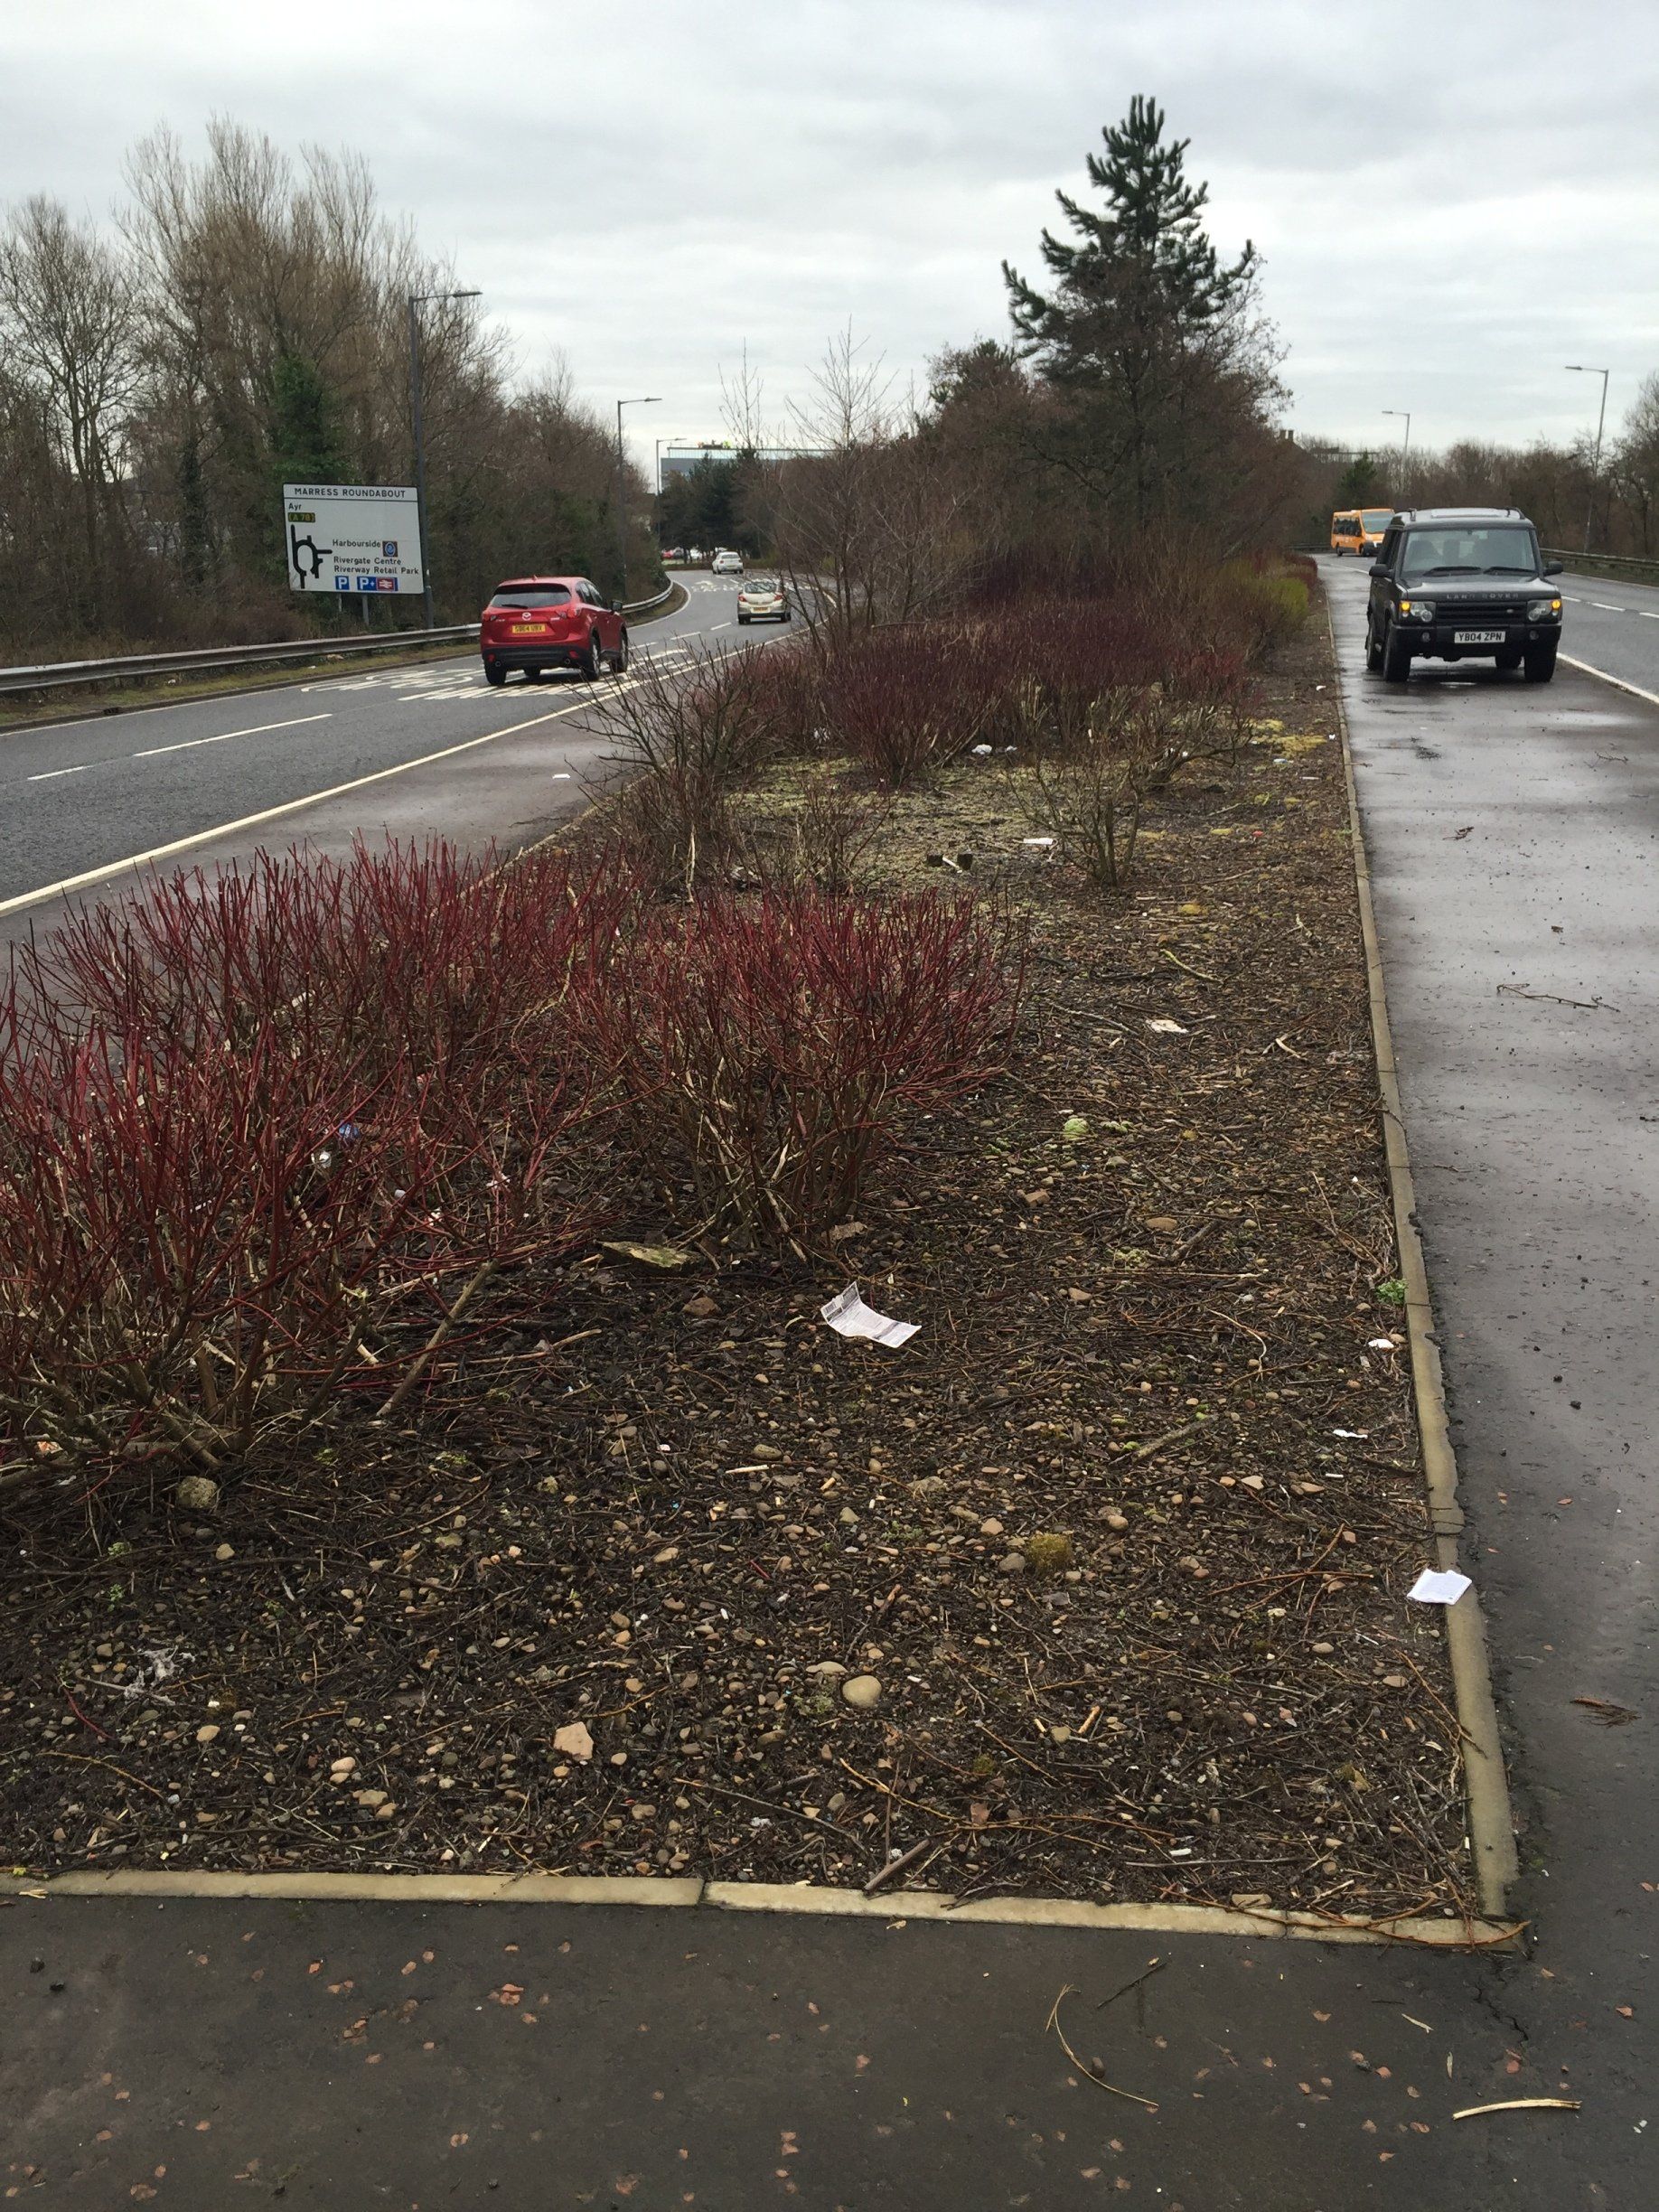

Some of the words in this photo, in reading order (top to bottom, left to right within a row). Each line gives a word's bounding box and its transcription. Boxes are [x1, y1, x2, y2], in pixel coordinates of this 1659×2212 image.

[295, 487, 339, 496] MARRESS
[342, 488, 406, 498] ROUNDABOUT
[288, 502, 302, 511] Ayr
[333, 539, 381, 548] Harbourside
[333, 556, 371, 565] Rivergate
[374, 557, 401, 566] Centre
[334, 565, 370, 575] Riverway
[373, 566, 398, 575] Retail
[401, 567, 419, 575] Park
[1458, 633, 1482, 642] YB04
[1484, 633, 1502, 641] ZPN
